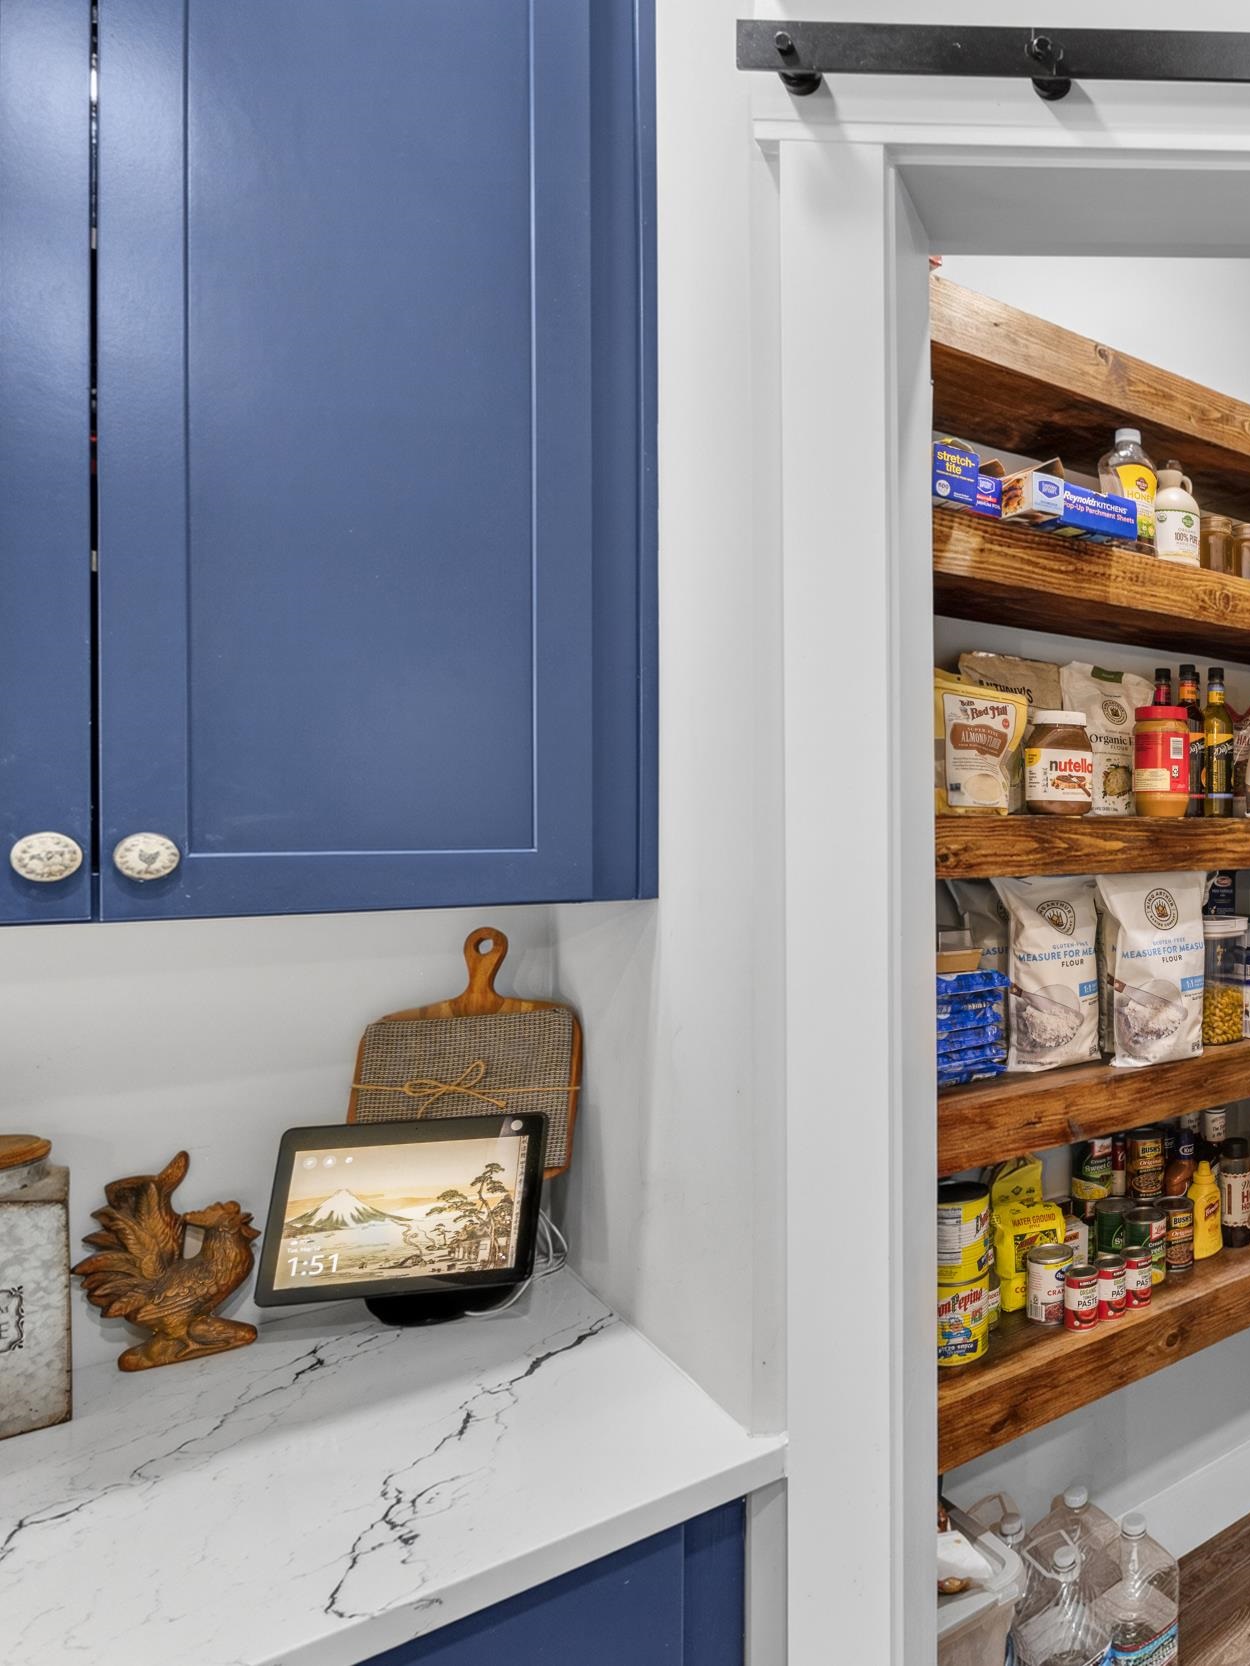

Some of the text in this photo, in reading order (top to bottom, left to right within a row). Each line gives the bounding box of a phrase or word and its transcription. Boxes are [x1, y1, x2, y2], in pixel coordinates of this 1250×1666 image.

[936, 450, 976, 468] stretch-
[945, 463, 962, 475] tite
[1063, 490, 1128, 515] Reynolds KITCHENS
[1085, 506, 1116, 520] Parchment
[1116, 514, 1135, 524] Sheets
[1174, 532, 1189, 541] 100%
[970, 705, 1008, 720] Red Mill
[1089, 733, 1129, 746] Organic
[1049, 757, 1093, 774] nutella
[1018, 951, 1062, 962] MEASURE
[1063, 949, 1081, 959] FOR
[1121, 947, 1162, 960] MEASURE
[1162, 945, 1178, 955] FOR
[1162, 954, 1183, 964] FLOUR
[1061, 958, 1085, 968] FLOUR
[1012, 1213, 1056, 1227] WATER GROUND
[1173, 1215, 1192, 1225] BUSH'S
[288, 1253, 339, 1277] 1:51
[1080, 1287, 1097, 1296] ORGANIC
[1077, 1296, 1098, 1308] PASTE
